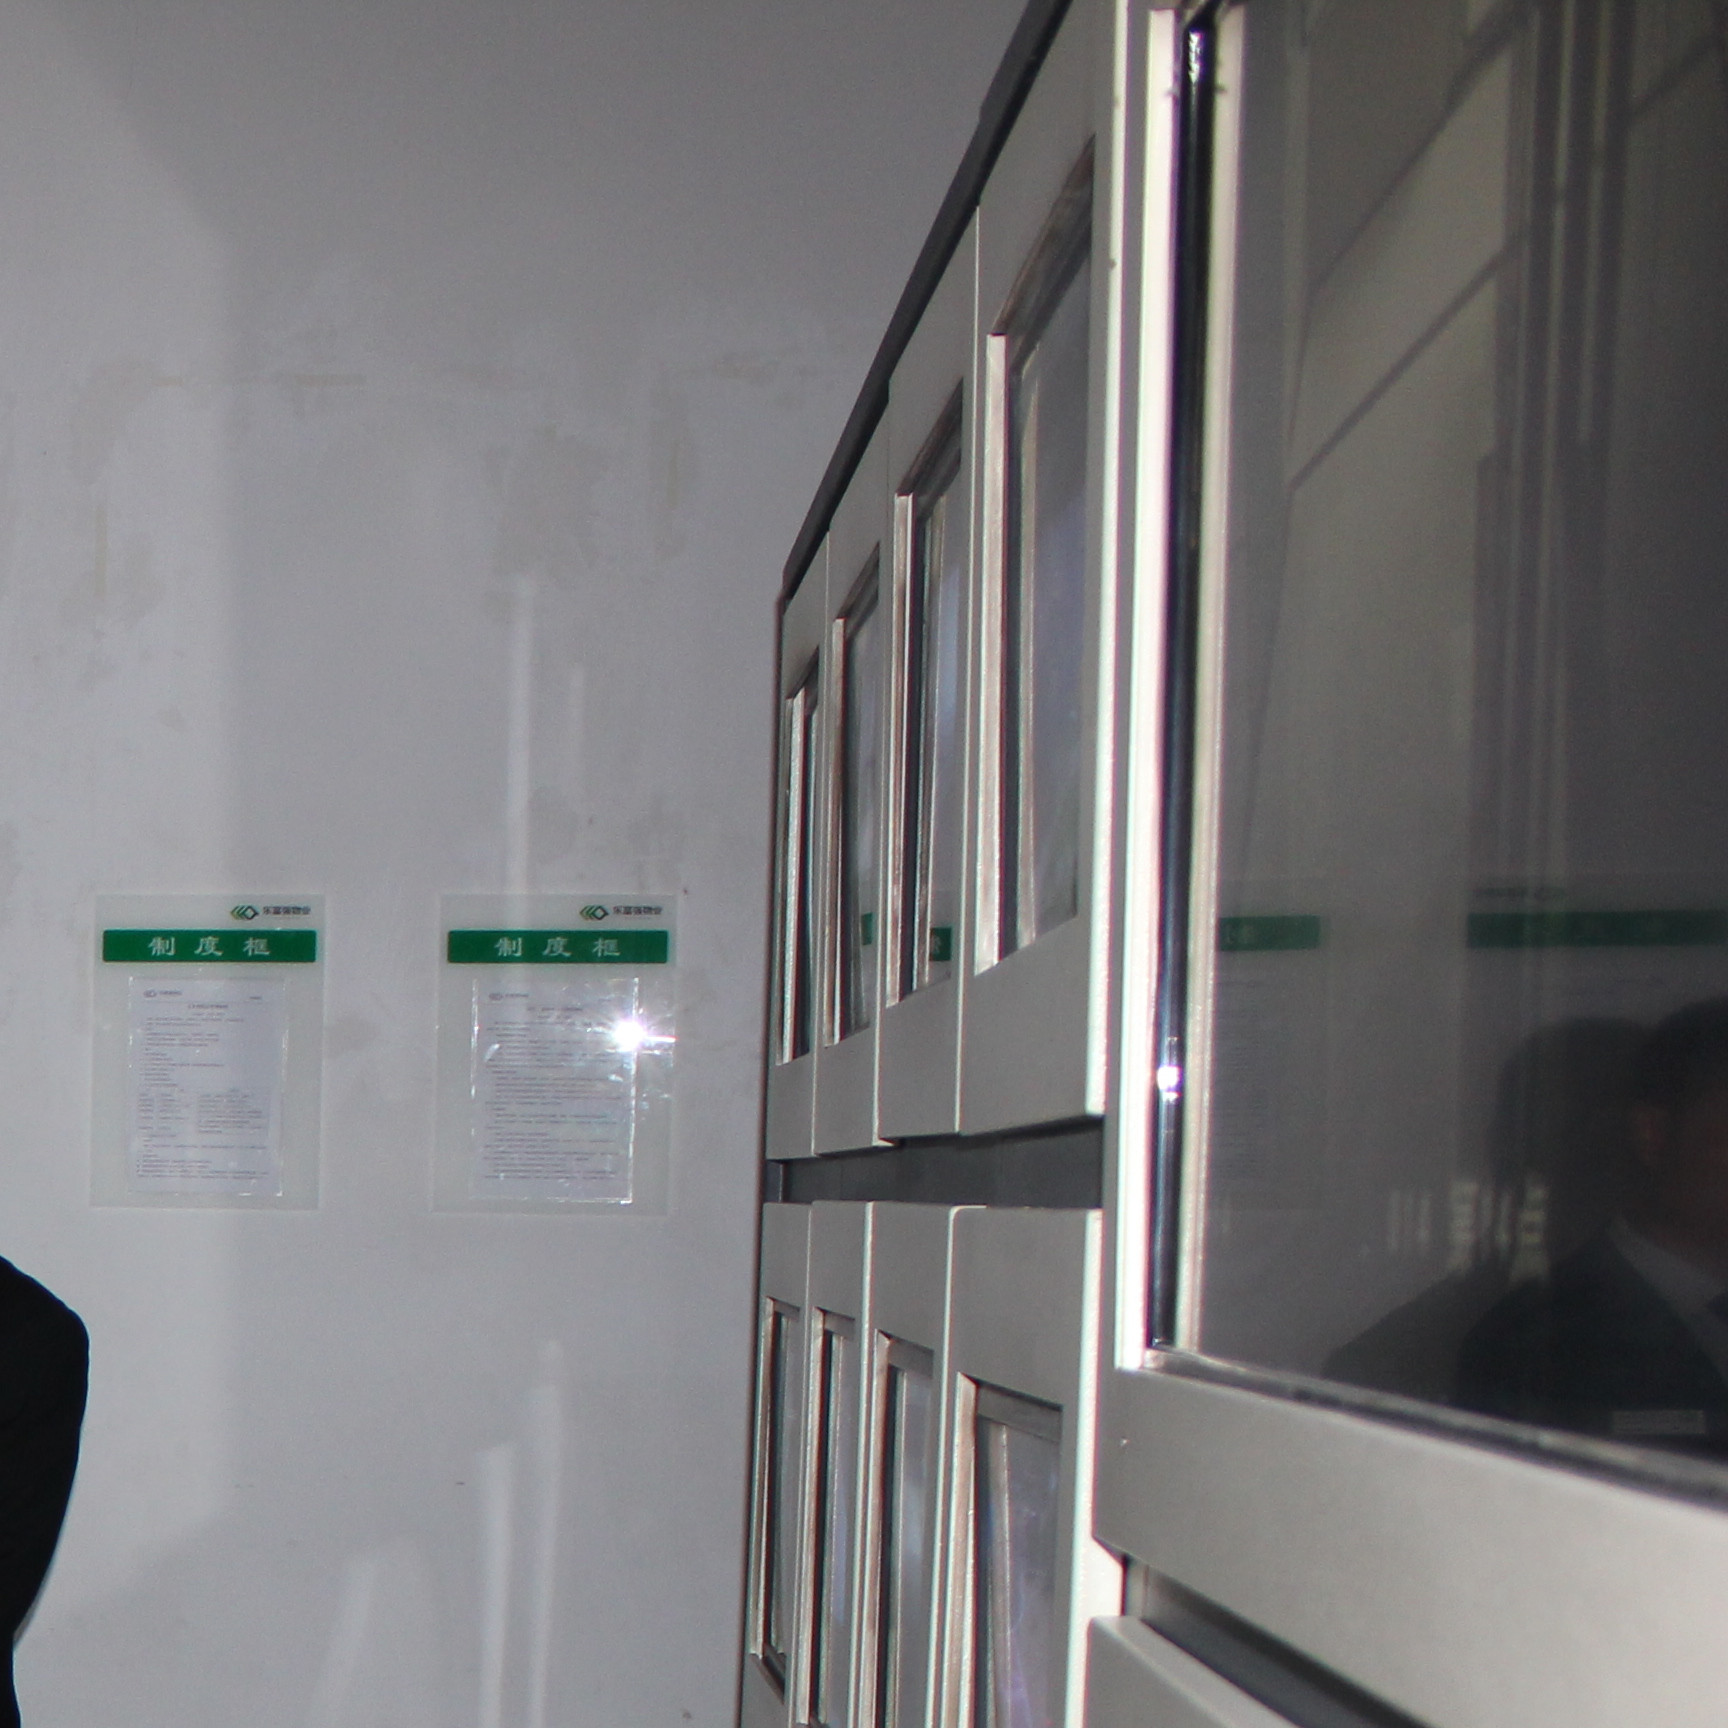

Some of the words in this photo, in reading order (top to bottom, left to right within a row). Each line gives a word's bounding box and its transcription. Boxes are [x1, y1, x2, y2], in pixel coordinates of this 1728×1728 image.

[148, 936, 270, 957] 制度框
[495, 936, 621, 958] 制度框
